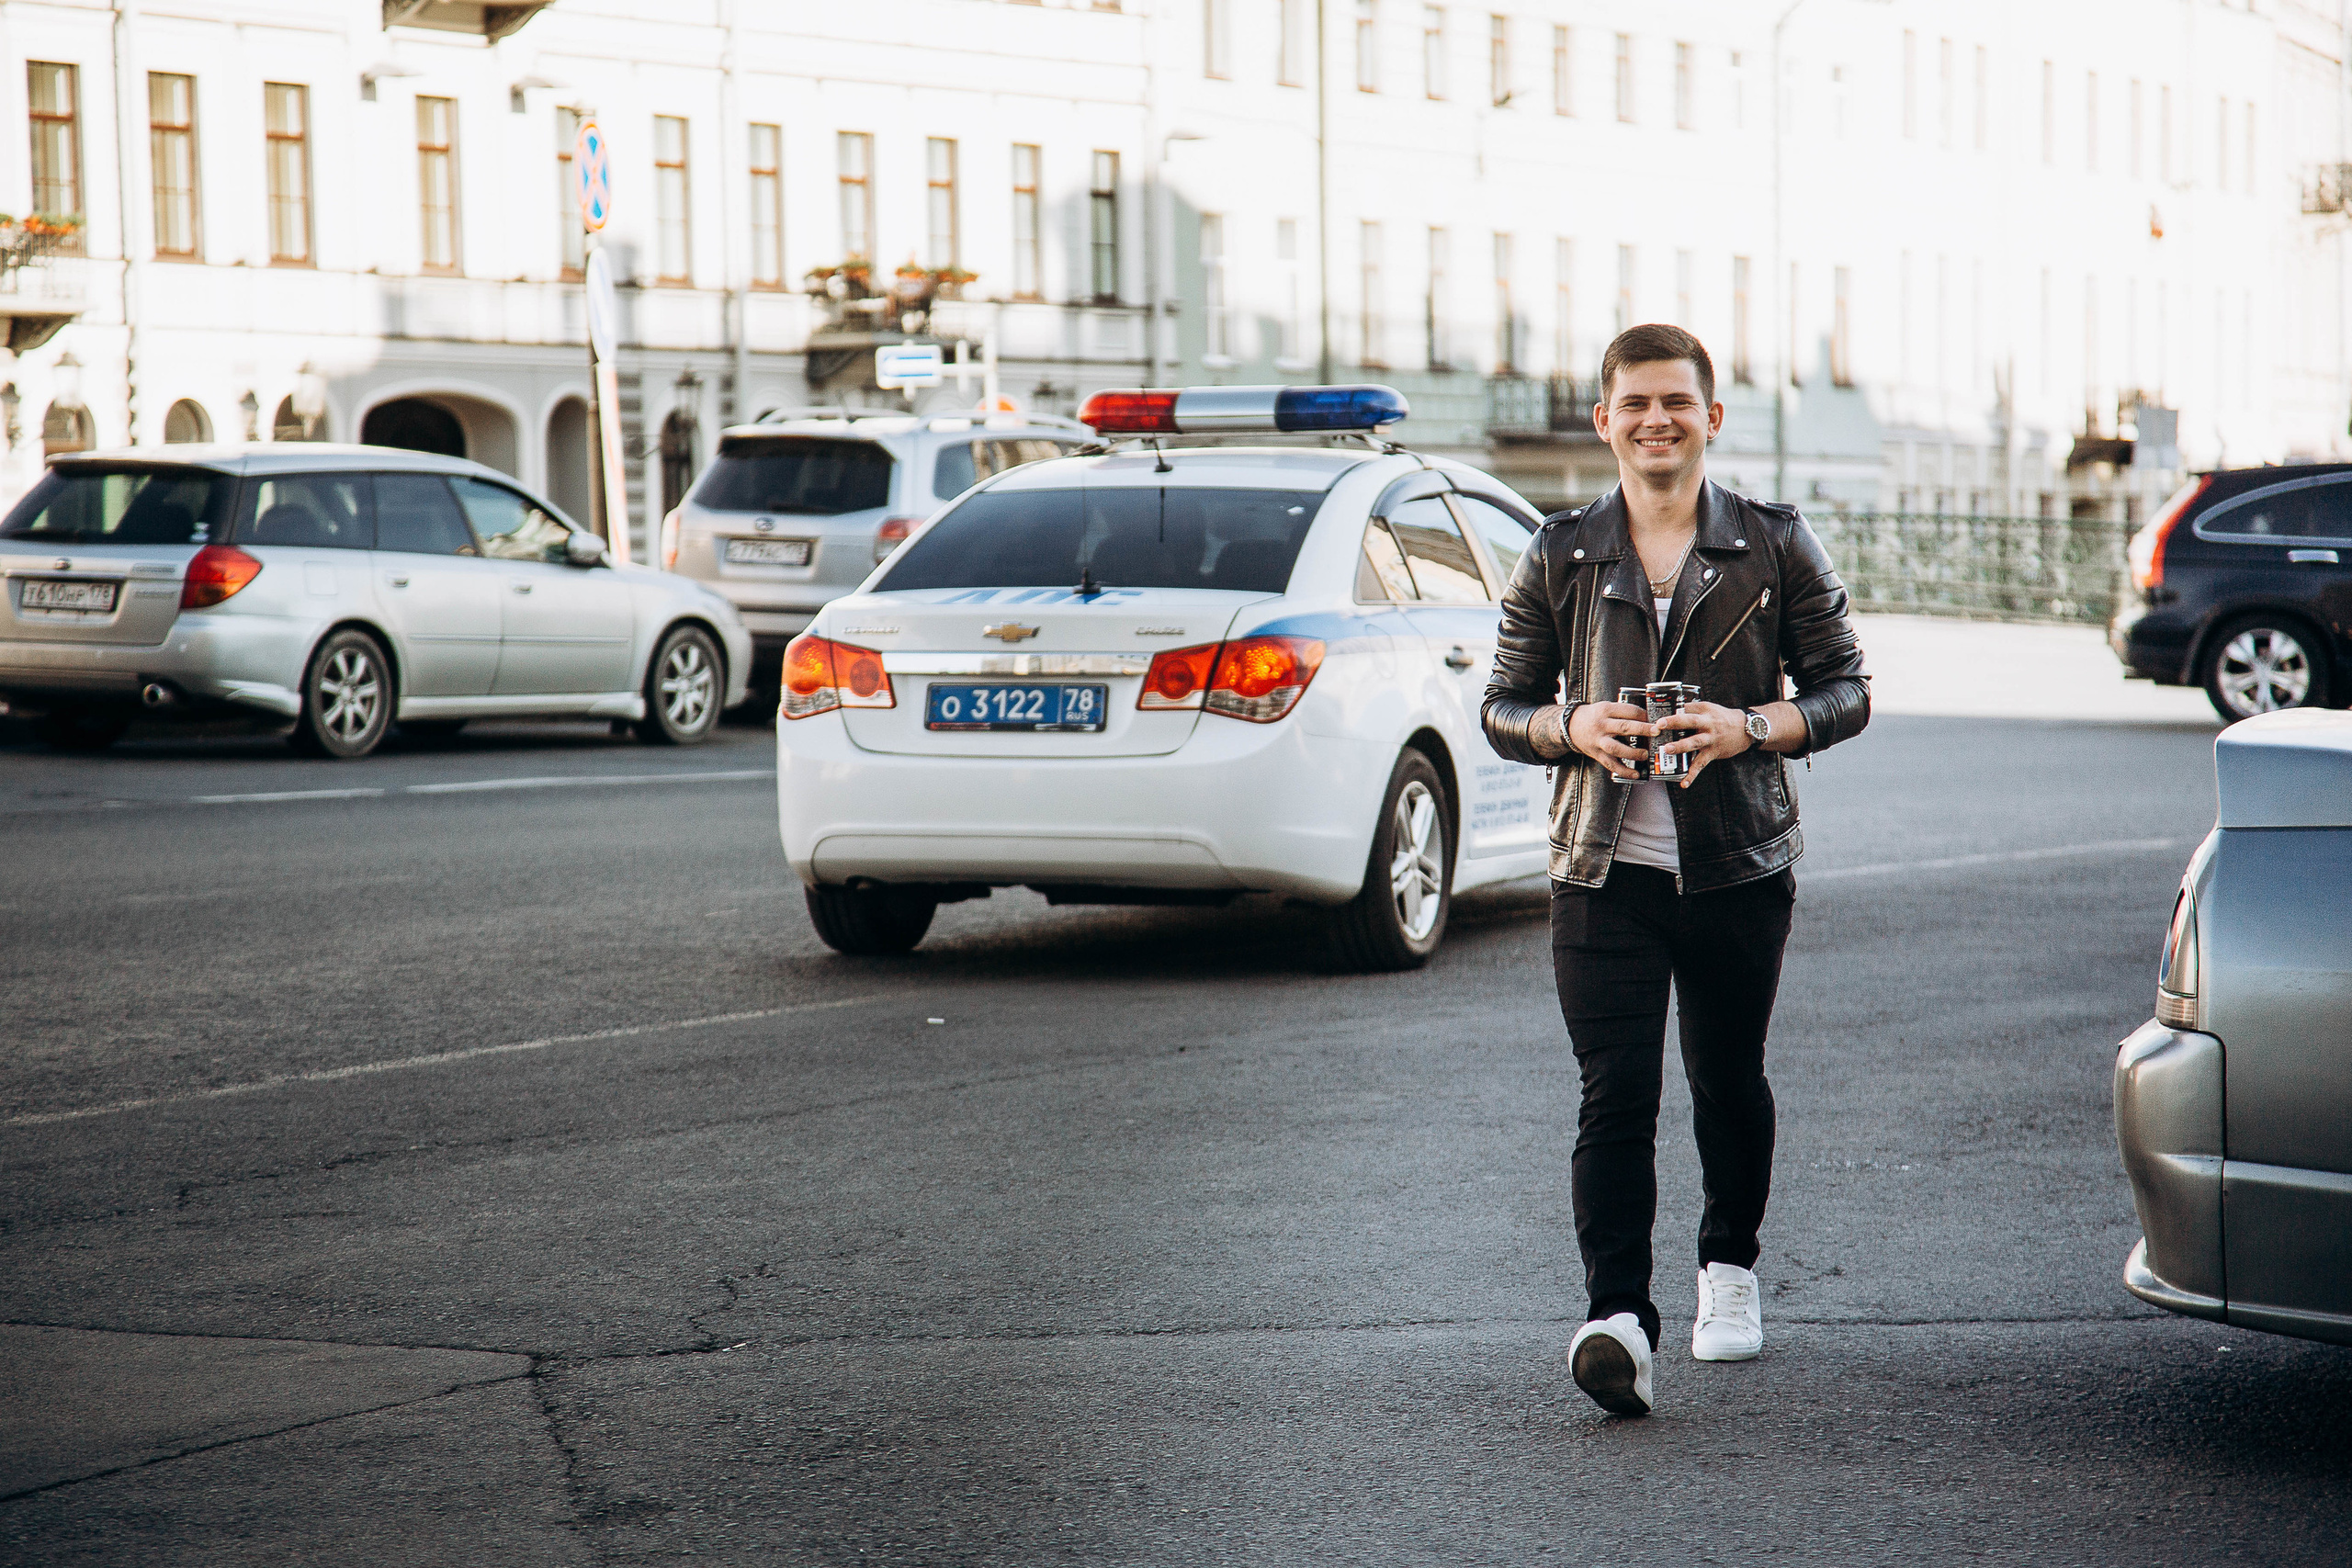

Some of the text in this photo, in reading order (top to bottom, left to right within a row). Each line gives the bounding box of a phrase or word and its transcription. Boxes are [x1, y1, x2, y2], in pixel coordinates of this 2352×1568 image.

[970, 689, 1046, 720] 3122
[1065, 688, 1094, 711] 78
[1066, 711, 1090, 721] RUS
